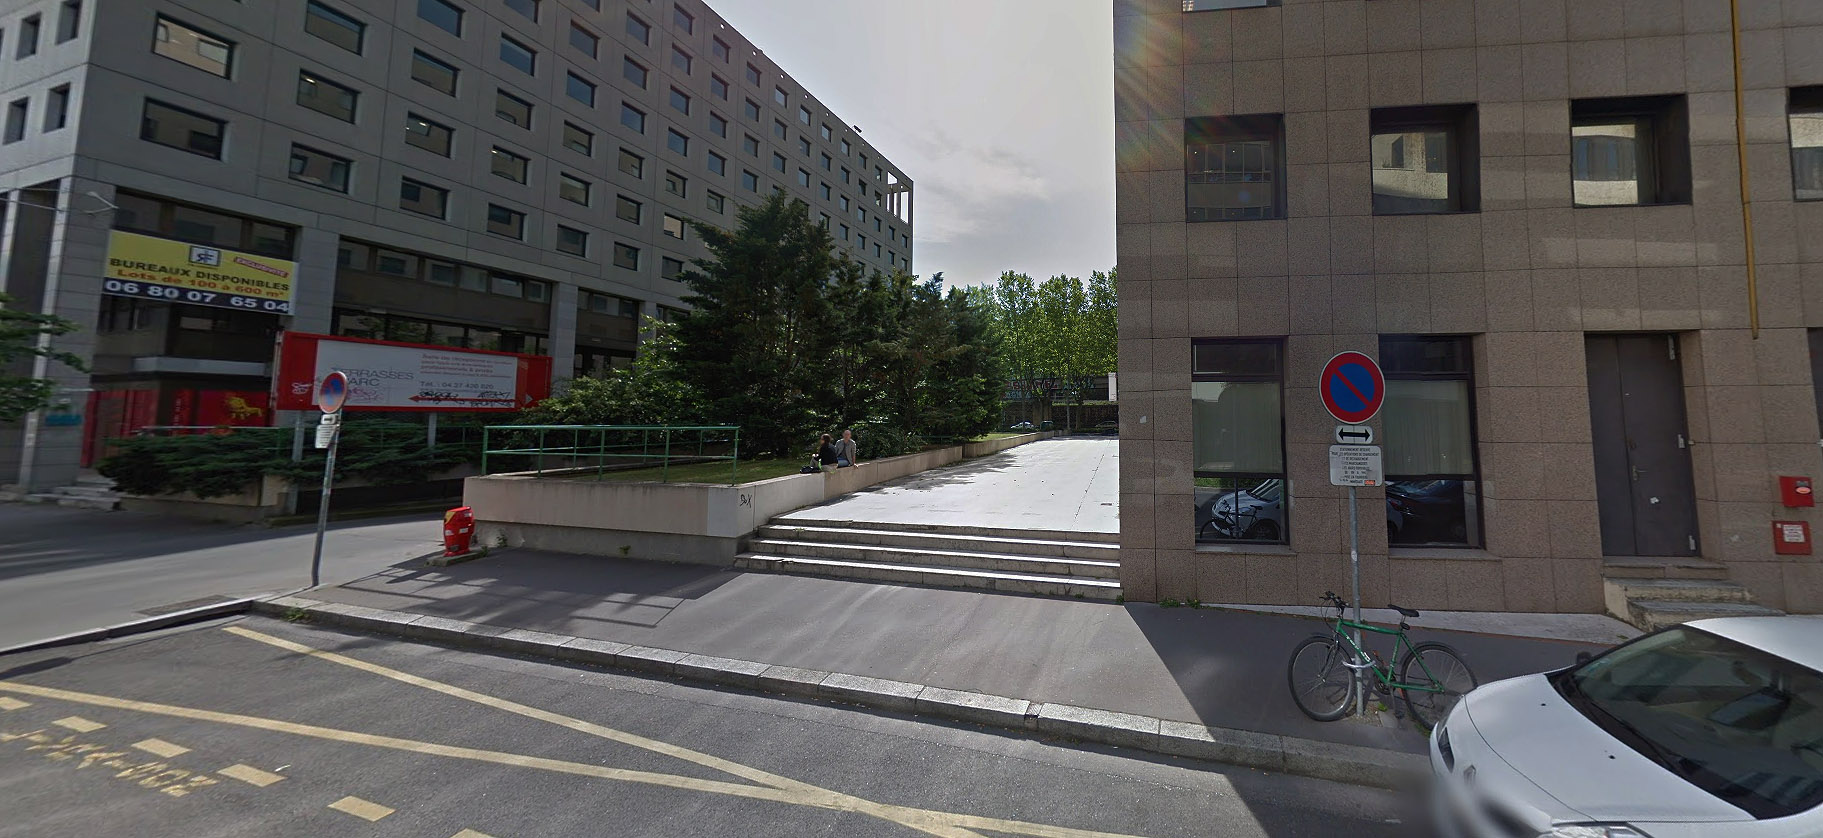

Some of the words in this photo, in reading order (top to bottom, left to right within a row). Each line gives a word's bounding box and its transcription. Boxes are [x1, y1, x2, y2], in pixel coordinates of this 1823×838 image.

[110, 258, 190, 277] BUREAUX
[195, 270, 290, 291] DISPONIBLES
[117, 269, 155, 281] Lots
[162, 275, 182, 284] de
[189, 279, 217, 289] 100
[235, 286, 262, 295] 600
[105, 280, 139, 294] 06
[147, 286, 180, 299] 80
[187, 291, 217, 303] 07
[230, 296, 258, 308] 65
[263, 300, 290, 312] 04
[347, 377, 380, 387] ARC
